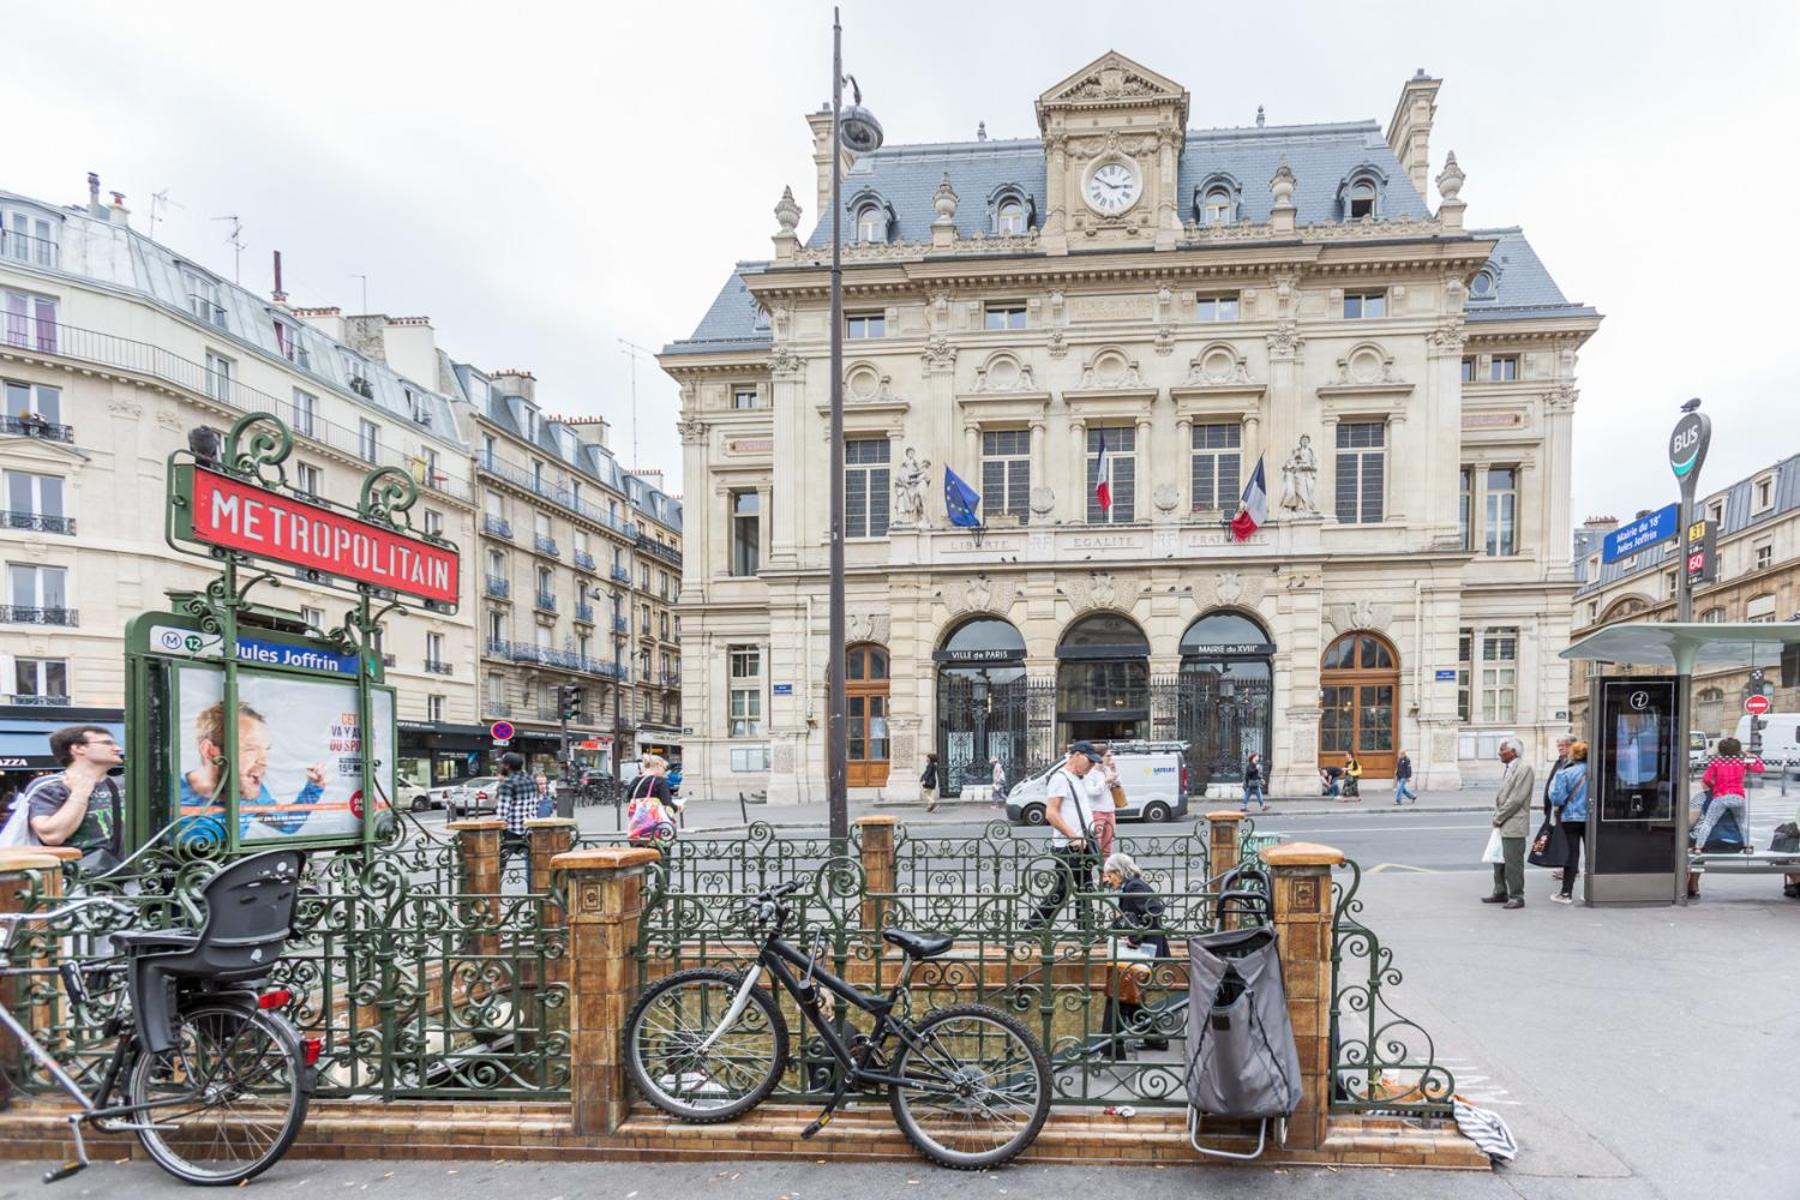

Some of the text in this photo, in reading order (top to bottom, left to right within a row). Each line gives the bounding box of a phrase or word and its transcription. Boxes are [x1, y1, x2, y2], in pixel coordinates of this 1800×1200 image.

[1673, 424, 1699, 454] BUS
[211, 488, 449, 591] METROPOLITAIN
[1690, 555, 1703, 570] 60
[185, 637, 201, 650] 12
[1198, 644, 1225, 654] MAIRIE
[1226, 644, 1237, 653] du
[282, 650, 339, 671] Joffrin
[951, 650, 1008, 660] VILLE de PARIS
